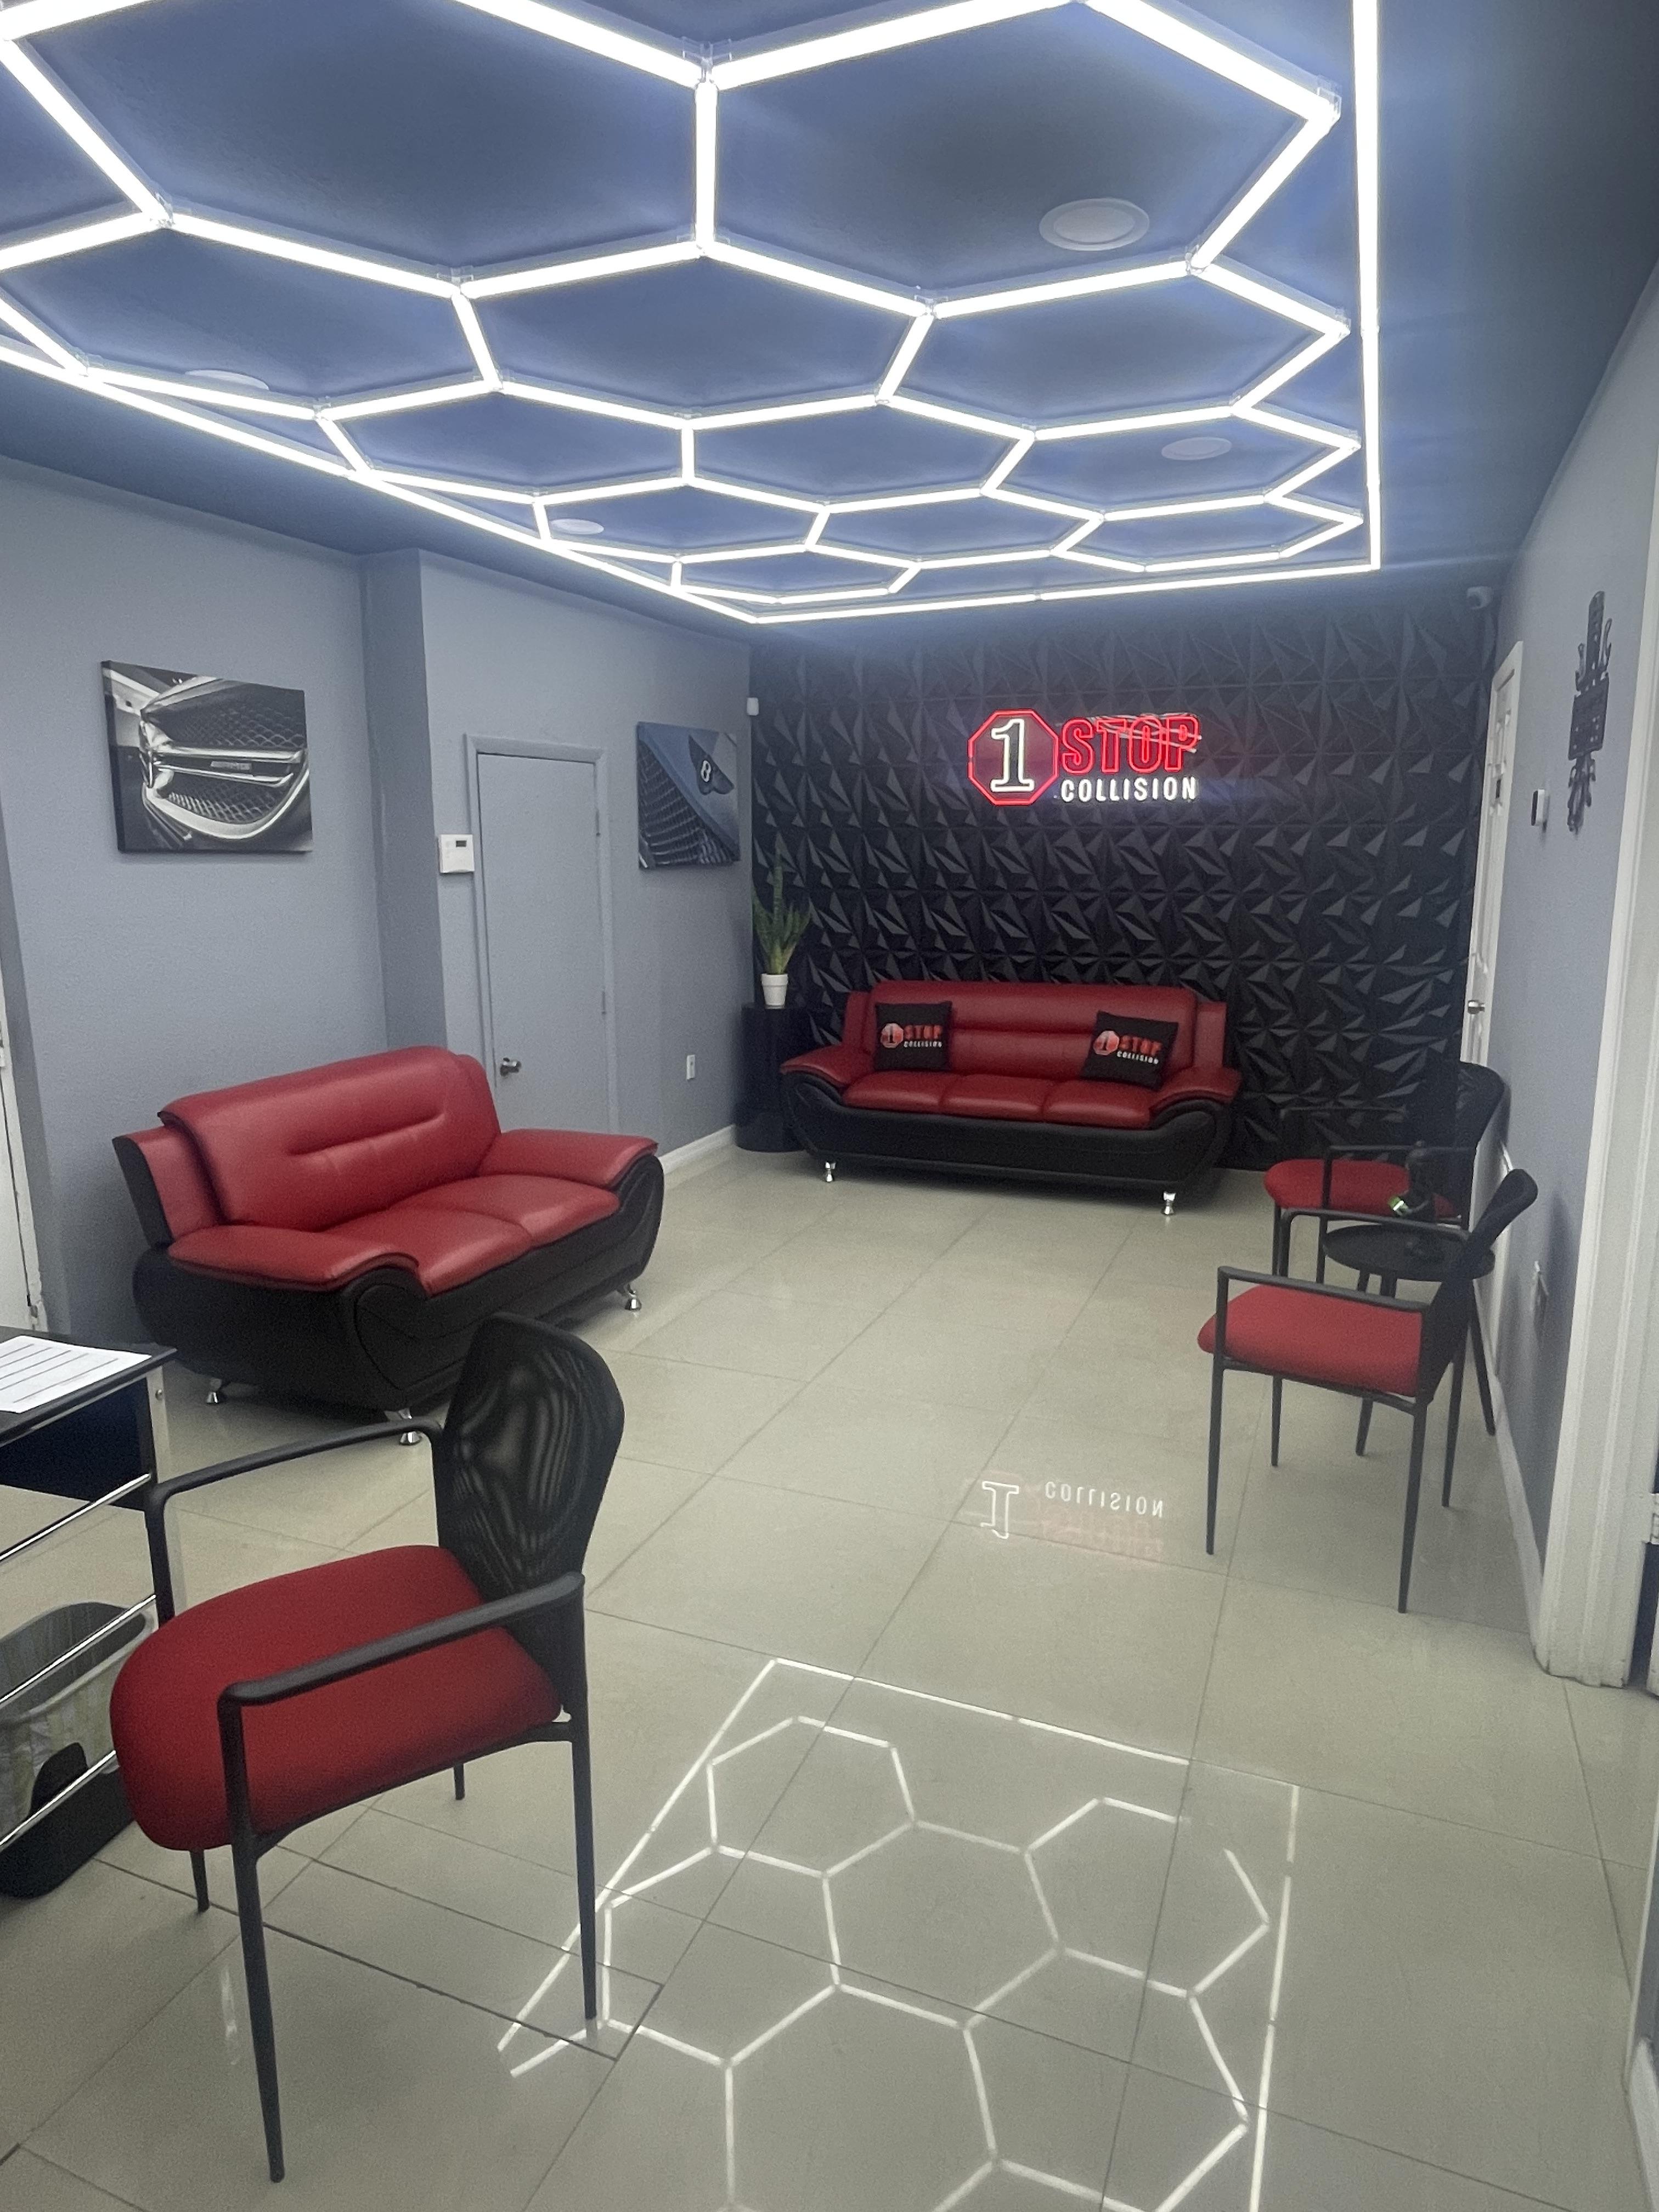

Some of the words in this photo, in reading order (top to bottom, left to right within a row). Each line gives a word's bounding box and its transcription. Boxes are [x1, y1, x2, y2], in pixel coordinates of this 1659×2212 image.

[990, 718, 1035, 792] 1
[1062, 715, 1200, 774] STOP
[1060, 777, 1197, 803] COLLISION
[905, 1025, 942, 1039] STOP
[1120, 1035, 1162, 1057] STOP
